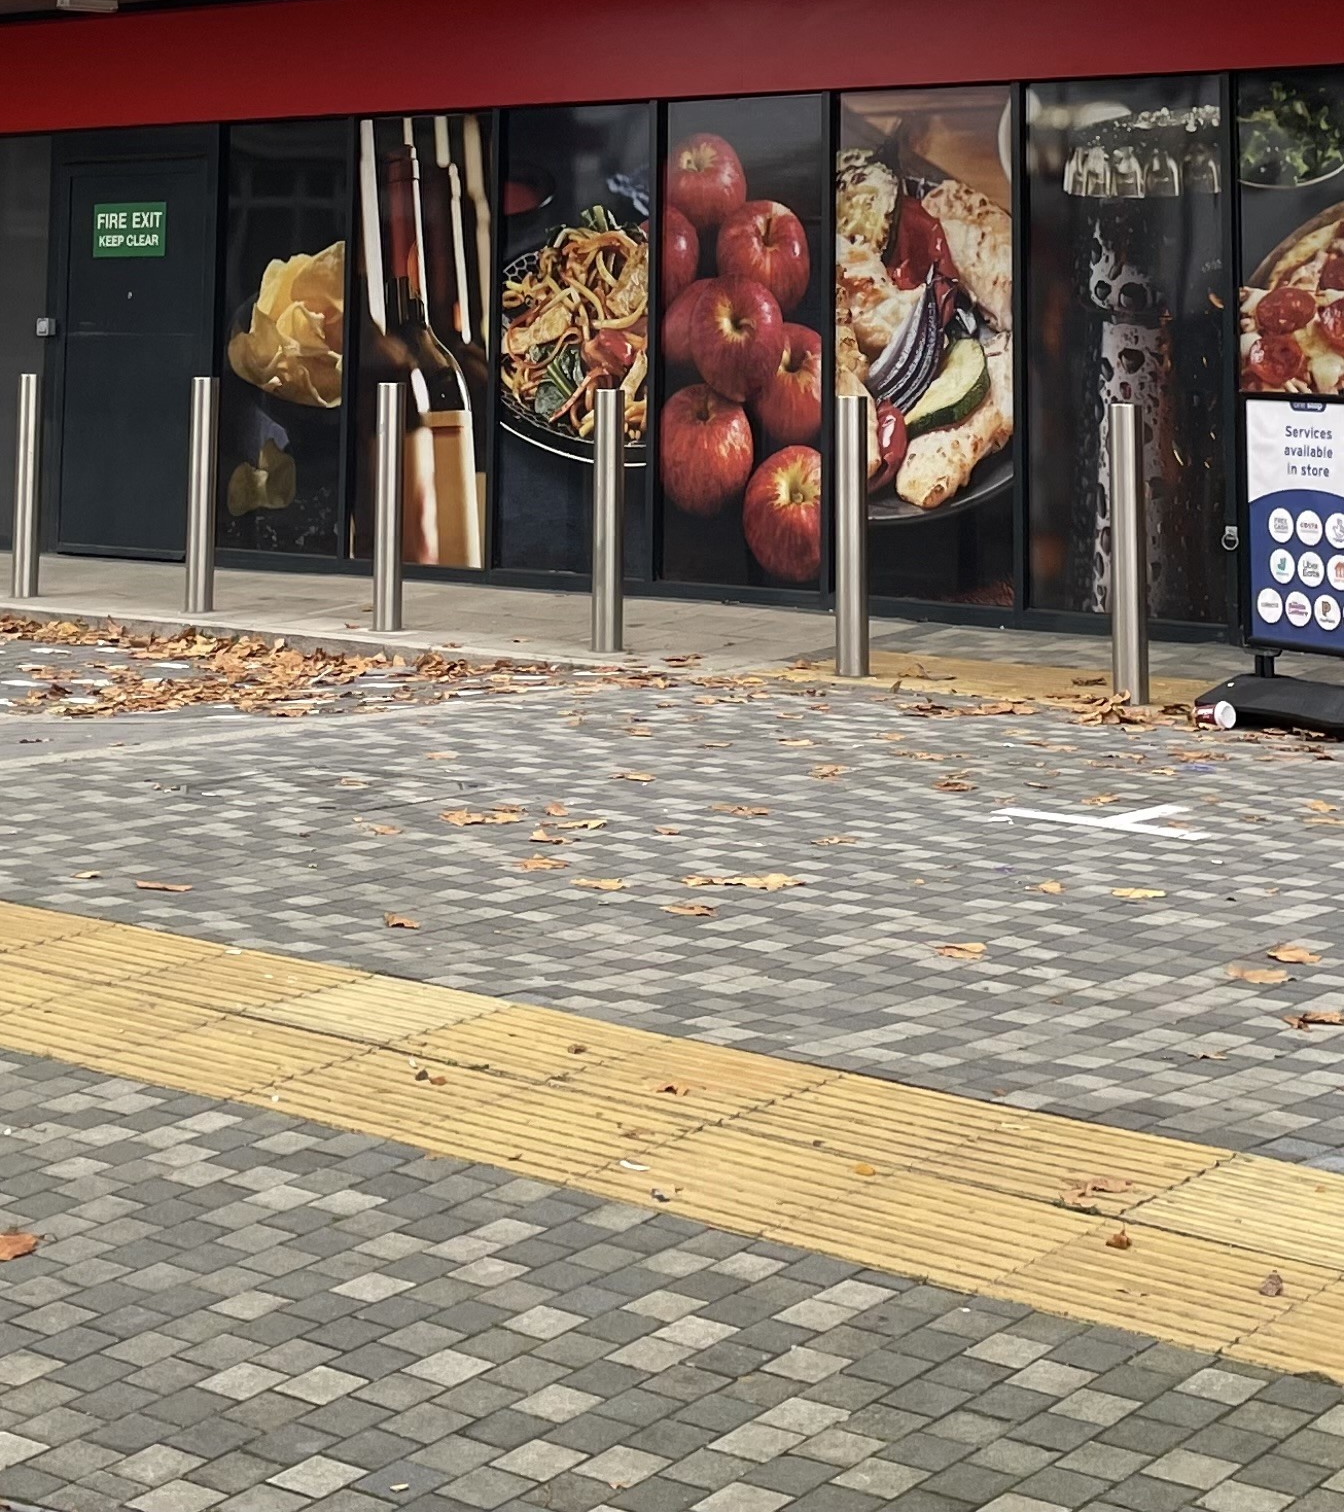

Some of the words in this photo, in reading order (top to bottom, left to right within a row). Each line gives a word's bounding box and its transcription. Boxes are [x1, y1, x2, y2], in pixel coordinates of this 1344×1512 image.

[97, 212, 127, 229] FIRE
[132, 211, 163, 228] EXIT
[99, 235, 124, 247] KEEP
[126, 234, 159, 247] CLEAR
[1285, 425, 1332, 440] Services
[1284, 445, 1333, 458] available
[1287, 462, 1297, 475] in
[1301, 464, 1329, 477] store
